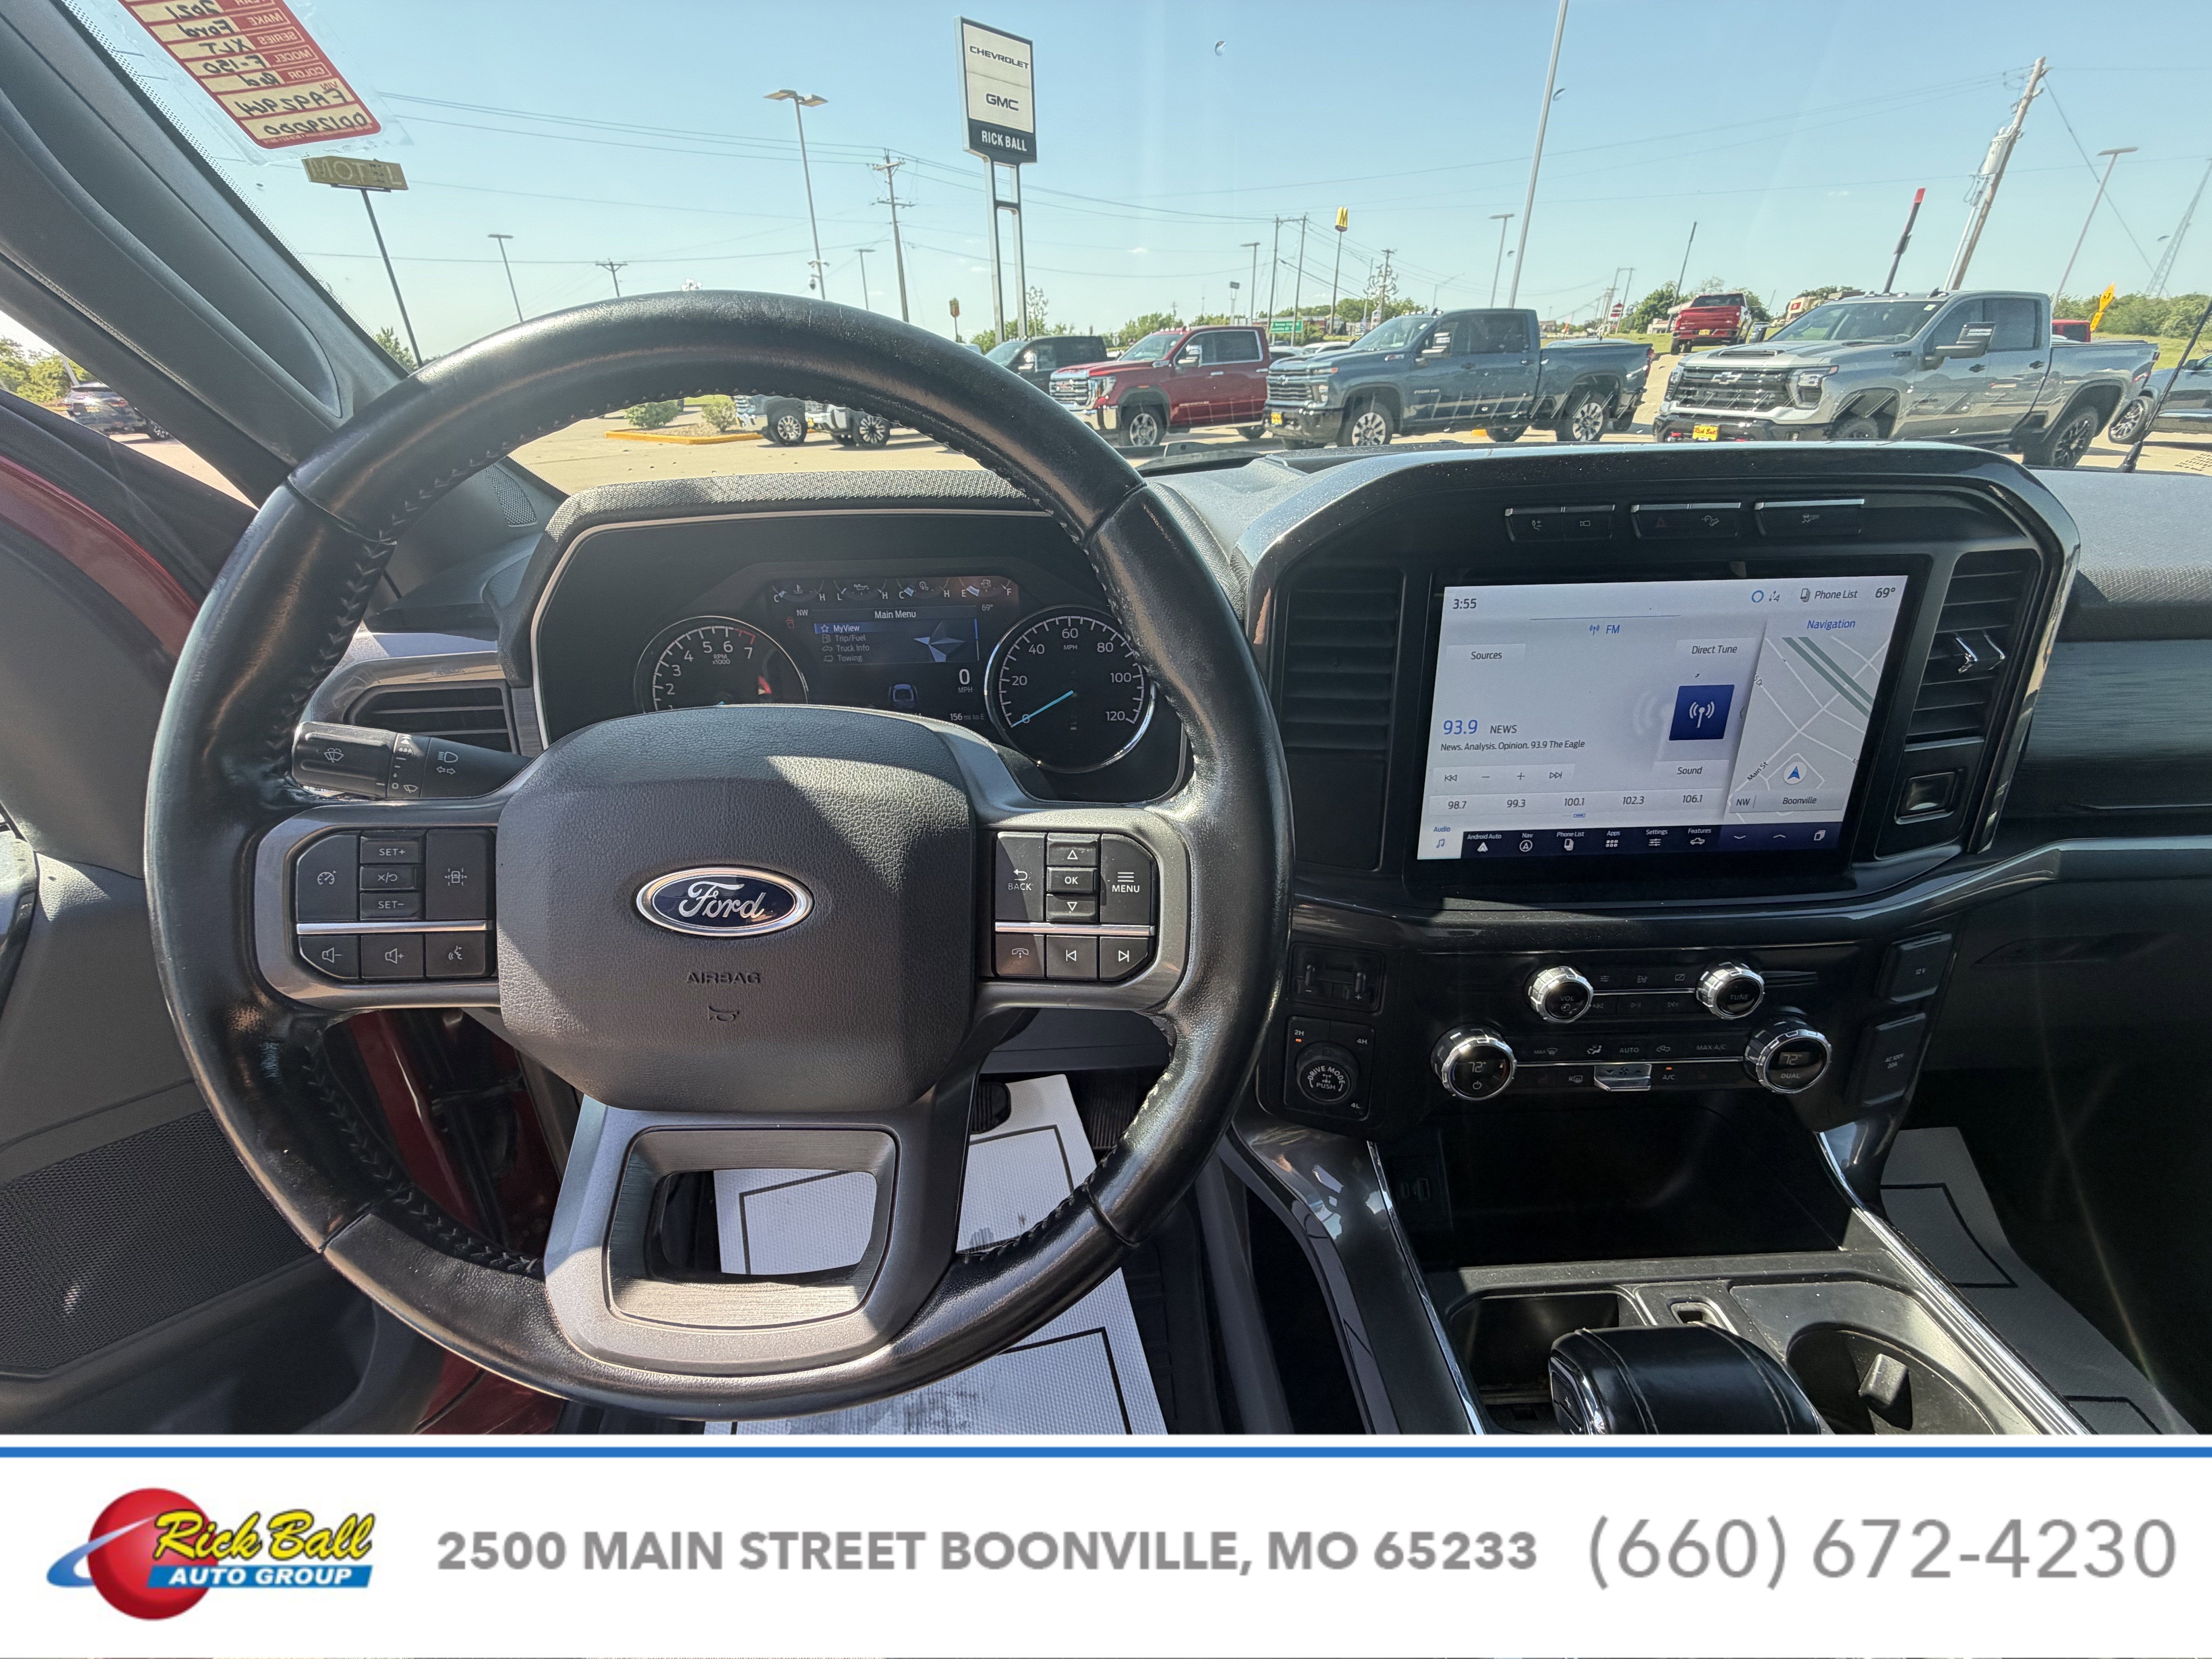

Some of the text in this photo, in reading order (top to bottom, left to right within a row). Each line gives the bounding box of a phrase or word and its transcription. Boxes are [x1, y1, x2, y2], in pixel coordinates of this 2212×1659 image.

[970, 46, 1029, 69] CHEVROLET
[986, 93, 1019, 111] GMC
[982, 130, 1027, 151] RICK BALL
[1814, 590, 1858, 599] Phone List
[1875, 587, 1896, 598] 69°
[1452, 598, 1477, 609] 3:55
[875, 610, 916, 619] Main Menu
[833, 625, 860, 633] MyView
[1606, 625, 1620, 634] FM
[1807, 620, 1855, 630] Navigation
[835, 634, 866, 642] Trip/Fuel
[1061, 628, 1079, 639] 60
[703, 642, 713, 653] 5
[723, 641, 733, 653] 6
[1028, 644, 1045, 654] 40
[1097, 642, 1114, 653] 80
[1692, 645, 1738, 655] Direct Tune
[684, 651, 694, 662] 4
[744, 647, 753, 659] 7
[1471, 651, 1503, 660] Sources
[672, 665, 681, 677] 3
[959, 669, 970, 685] 0
[1012, 675, 1027, 686] 20
[1110, 672, 1132, 683] 100
[666, 684, 675, 695] 2
[1022, 714, 1030, 724] 0
[1106, 711, 1125, 721] 120
[1443, 720, 1517, 735] 93.9 NEWS
[1441, 743, 1462, 752] News.
[1464, 742, 1497, 751] Analysis.
[1498, 741, 1528, 750] Opinion.
[1549, 740, 1563, 748] The
[1564, 740, 1585, 749] Eagle
[1677, 766, 1702, 775] Sound
[1747, 768, 1762, 781] Main
[1507, 799, 1526, 808] 99.3
[1564, 798, 1585, 807] 100.1
[1623, 796, 1644, 805] 102.3
[1682, 794, 1702, 803] 106.1
[1783, 796, 1817, 804] Boonville
[1448, 801, 1467, 809] 98.7
[379, 848, 405, 856] SET+
[1065, 876, 1078, 884] OK
[1008, 883, 1032, 891] BACK
[678, 881, 768, 918] Ford
[686, 972, 761, 984] AIRBAG
[1307, 1065, 1345, 1085] DRIVE MODE
[1316, 1082, 1336, 1091] PUSH
